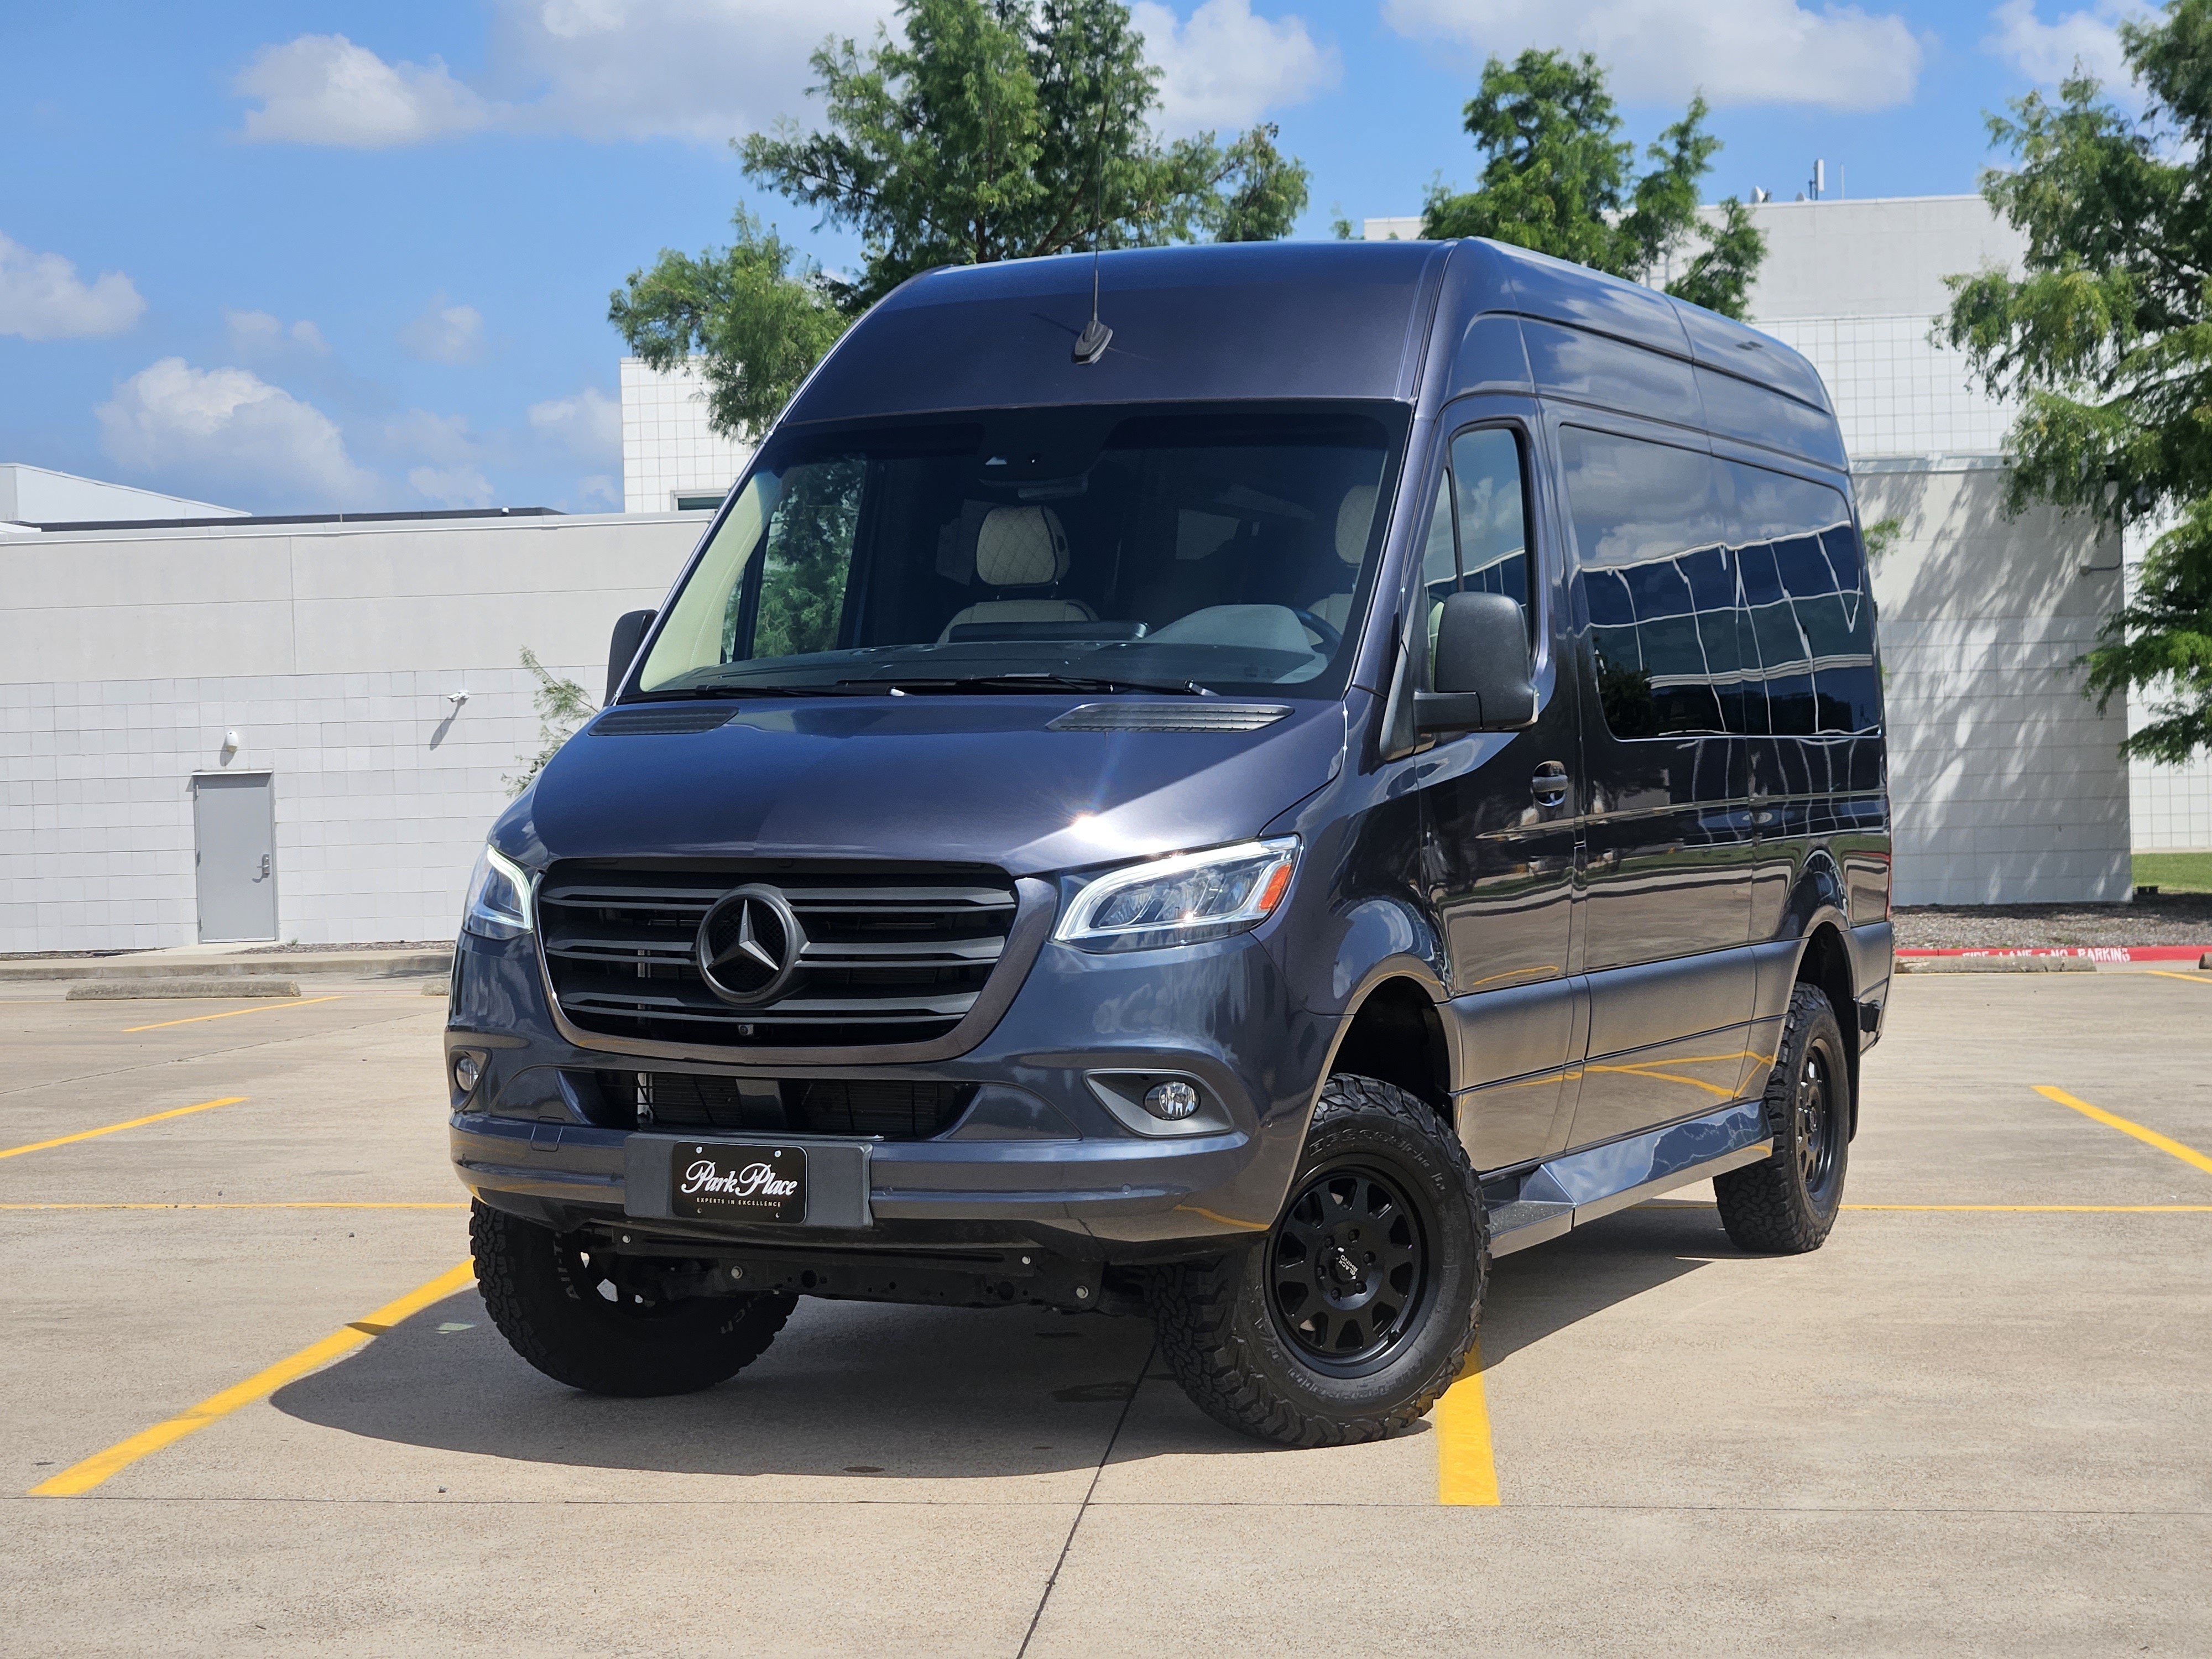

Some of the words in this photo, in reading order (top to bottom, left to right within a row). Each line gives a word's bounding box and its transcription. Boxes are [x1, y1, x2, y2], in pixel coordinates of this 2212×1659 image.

[2077, 947, 2131, 962] PARKING
[681, 1160, 738, 1193] Park
[734, 1162, 798, 1196] Place
[1338, 1259, 1356, 1276] BLACK
[1340, 1254, 1358, 1272] RHINO
